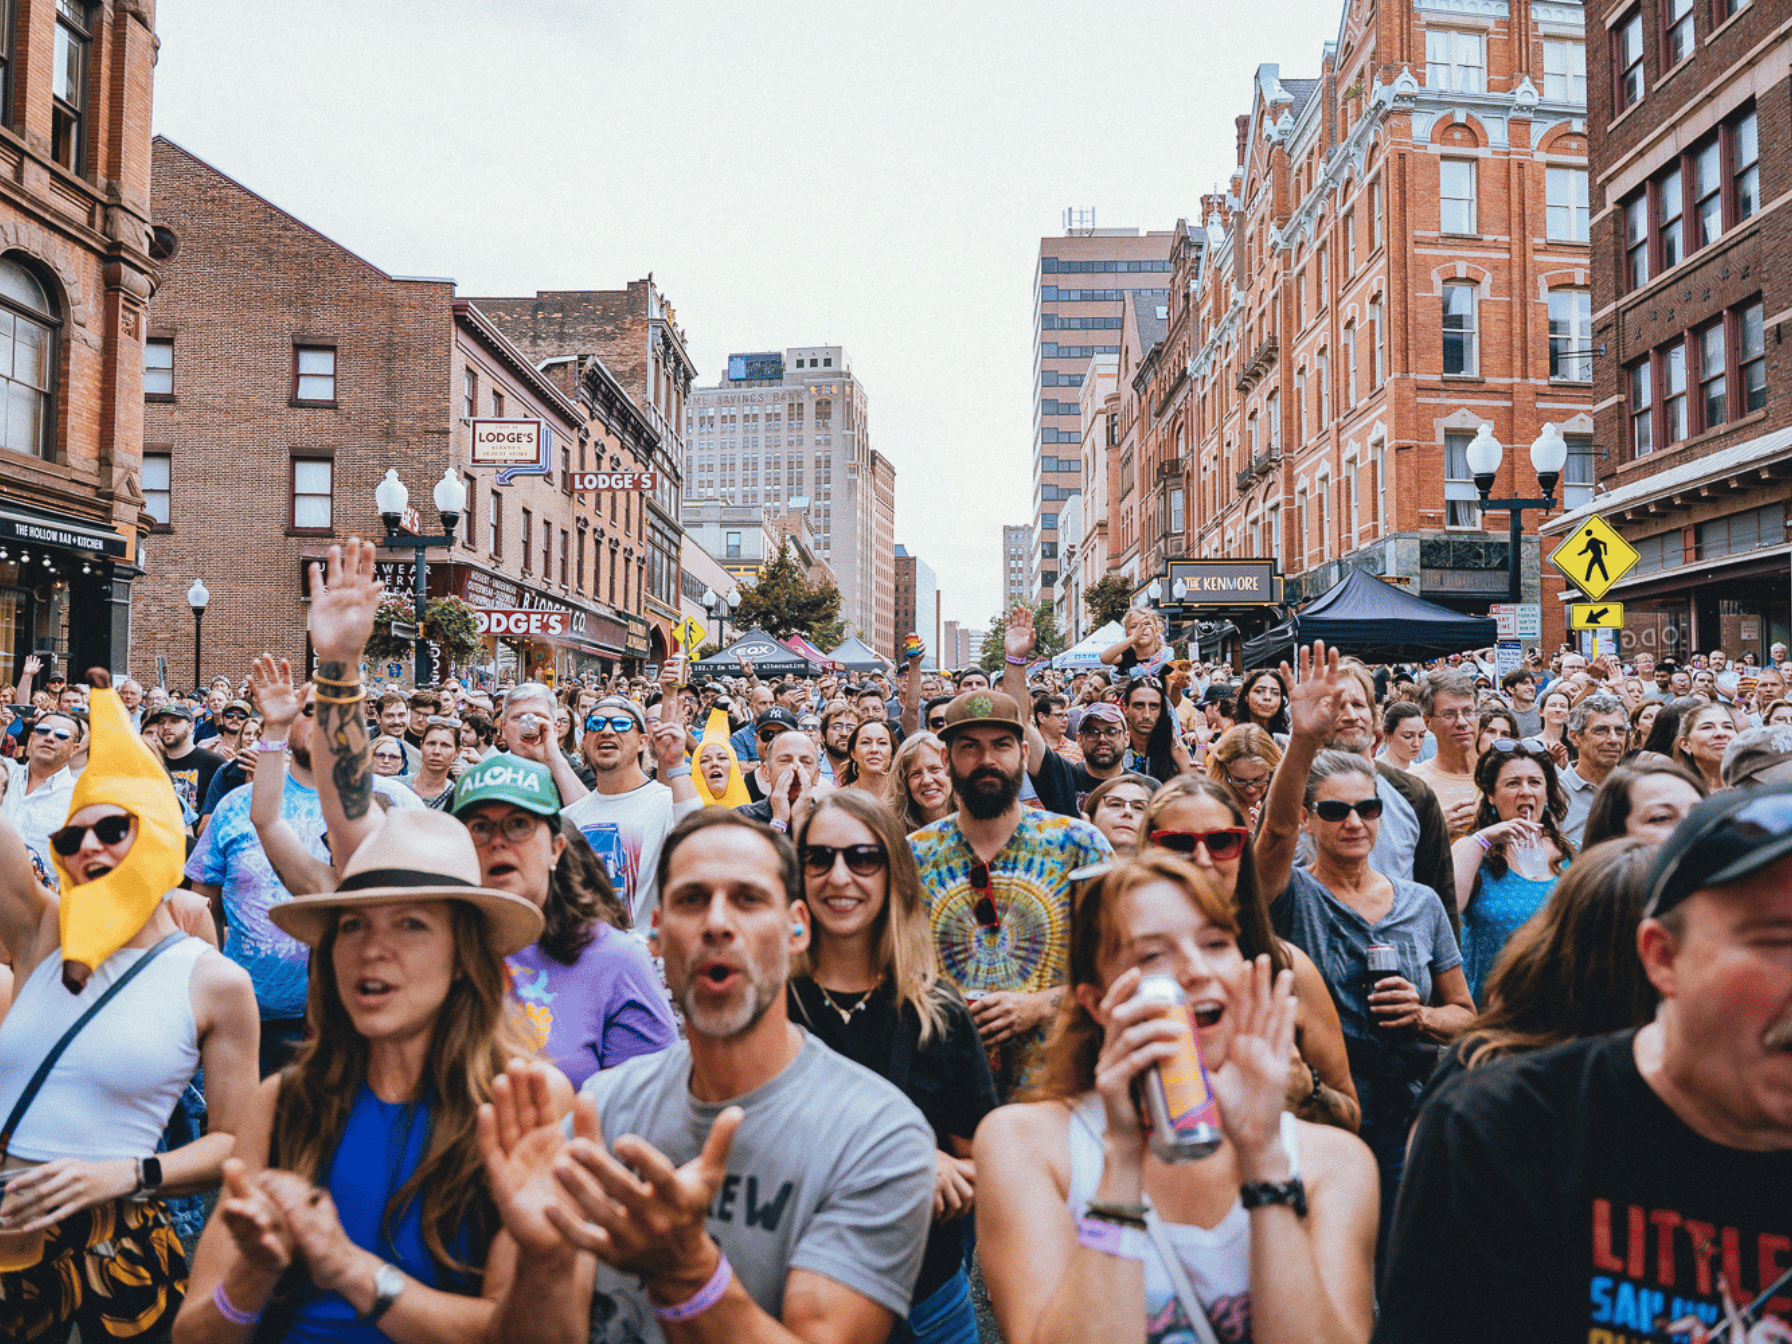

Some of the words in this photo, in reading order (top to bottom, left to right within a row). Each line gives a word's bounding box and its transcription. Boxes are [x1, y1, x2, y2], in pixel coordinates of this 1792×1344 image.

[717, 393, 764, 405] SAVINGS
[773, 390, 803, 402] BANK
[478, 432, 534, 443] LODGE'S
[574, 473, 652, 490] LODGE'S
[402, 508, 420, 533] GE'S
[15, 523, 29, 536] THE
[28, 526, 58, 541] HOLLOW
[59, 531, 72, 545] BAR
[77, 536, 104, 550] KITCHEN
[1203, 576, 1259, 591] KENMORE
[475, 611, 562, 636] ODGE'S
[736, 646, 769, 656] EQX
[460, 766, 541, 797] ALOHA
[708, 1173, 794, 1232] EW
[1592, 1197, 1792, 1312] LITTLE
